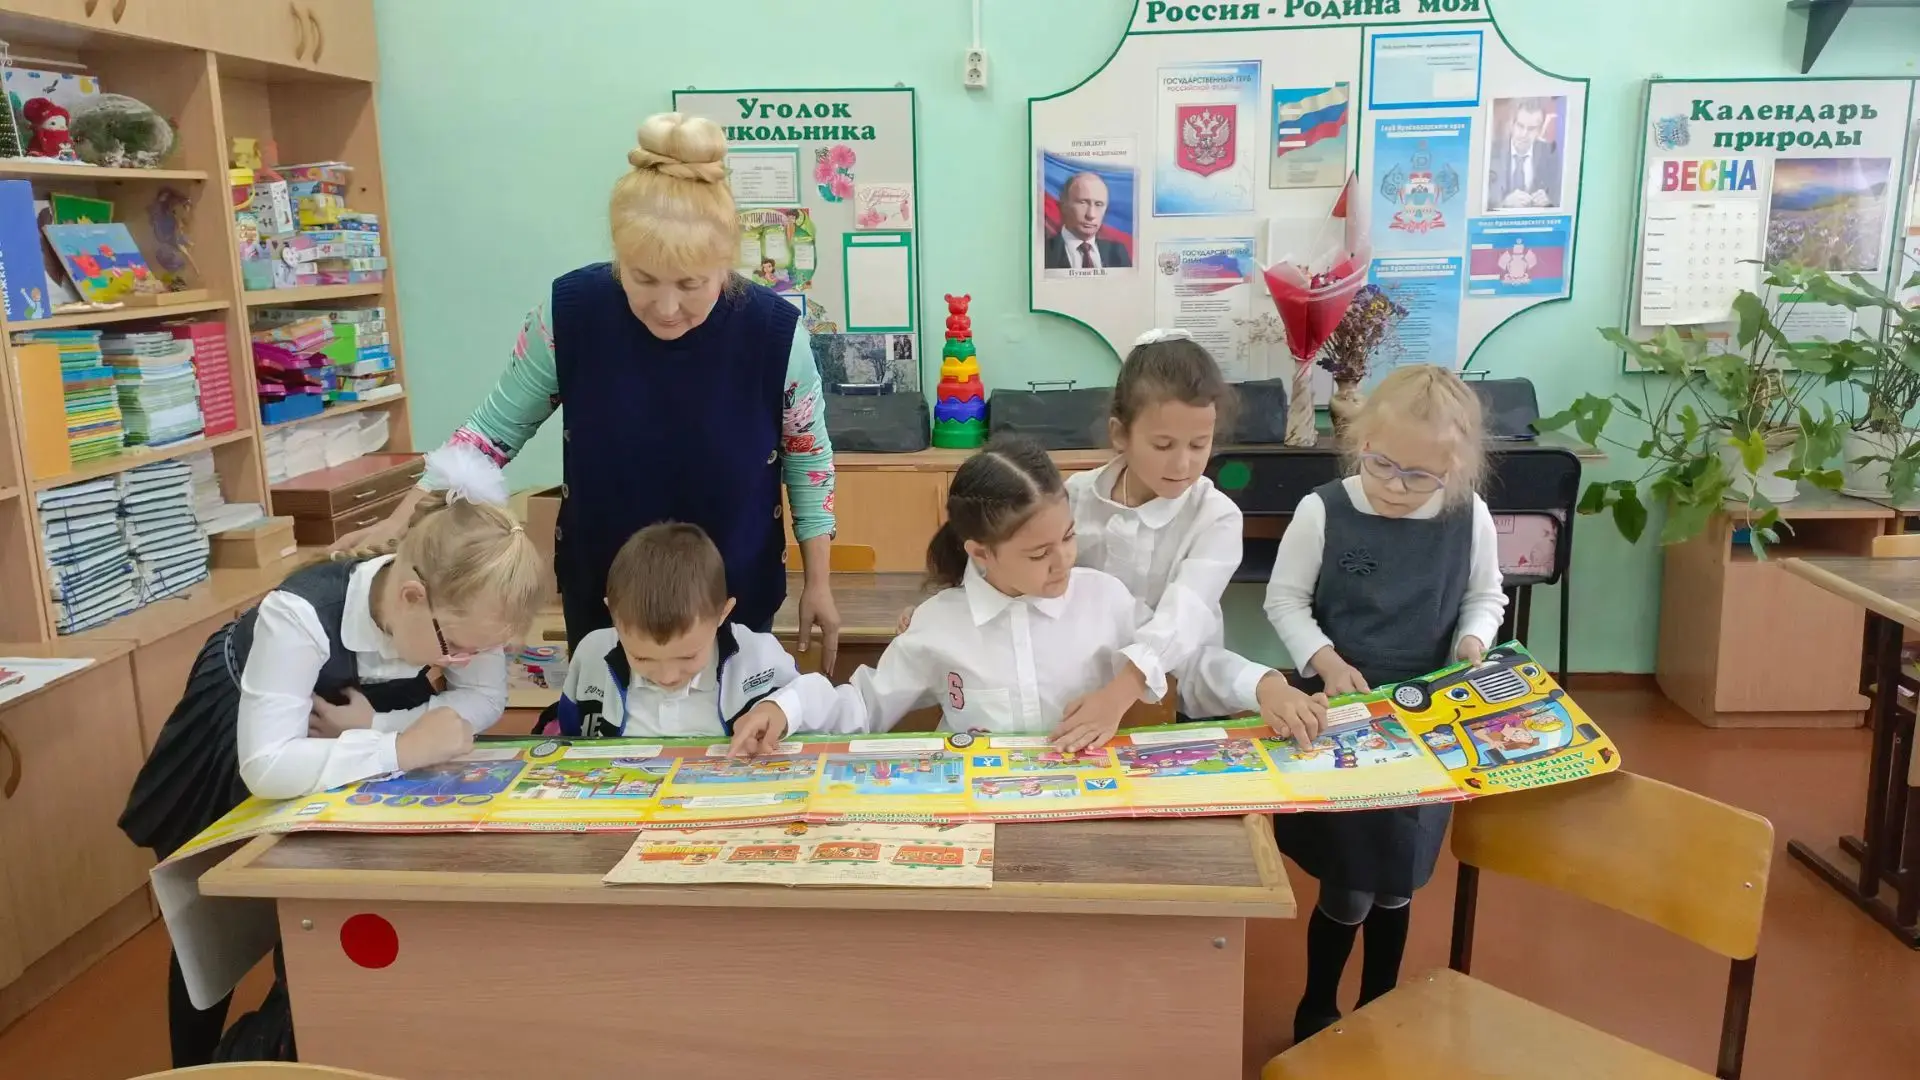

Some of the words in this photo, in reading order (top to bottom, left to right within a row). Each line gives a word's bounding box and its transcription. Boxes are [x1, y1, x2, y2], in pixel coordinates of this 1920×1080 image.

[1146, 1, 1260, 23] Россия
[1284, 0, 1400, 19] Родина
[1417, 0, 1480, 13] моя
[736, 98, 852, 119] Уголок
[1690, 99, 1878, 124] Календарь
[1713, 130, 1862, 151] природы
[1661, 159, 1757, 192] ВЕСНА
[1487, 751, 1584, 778] ДВИЖЕНИЯ
[1488, 757, 1595, 785] ДОРОЖНОГО
[1508, 768, 1591, 788] ПРАВИЛА
